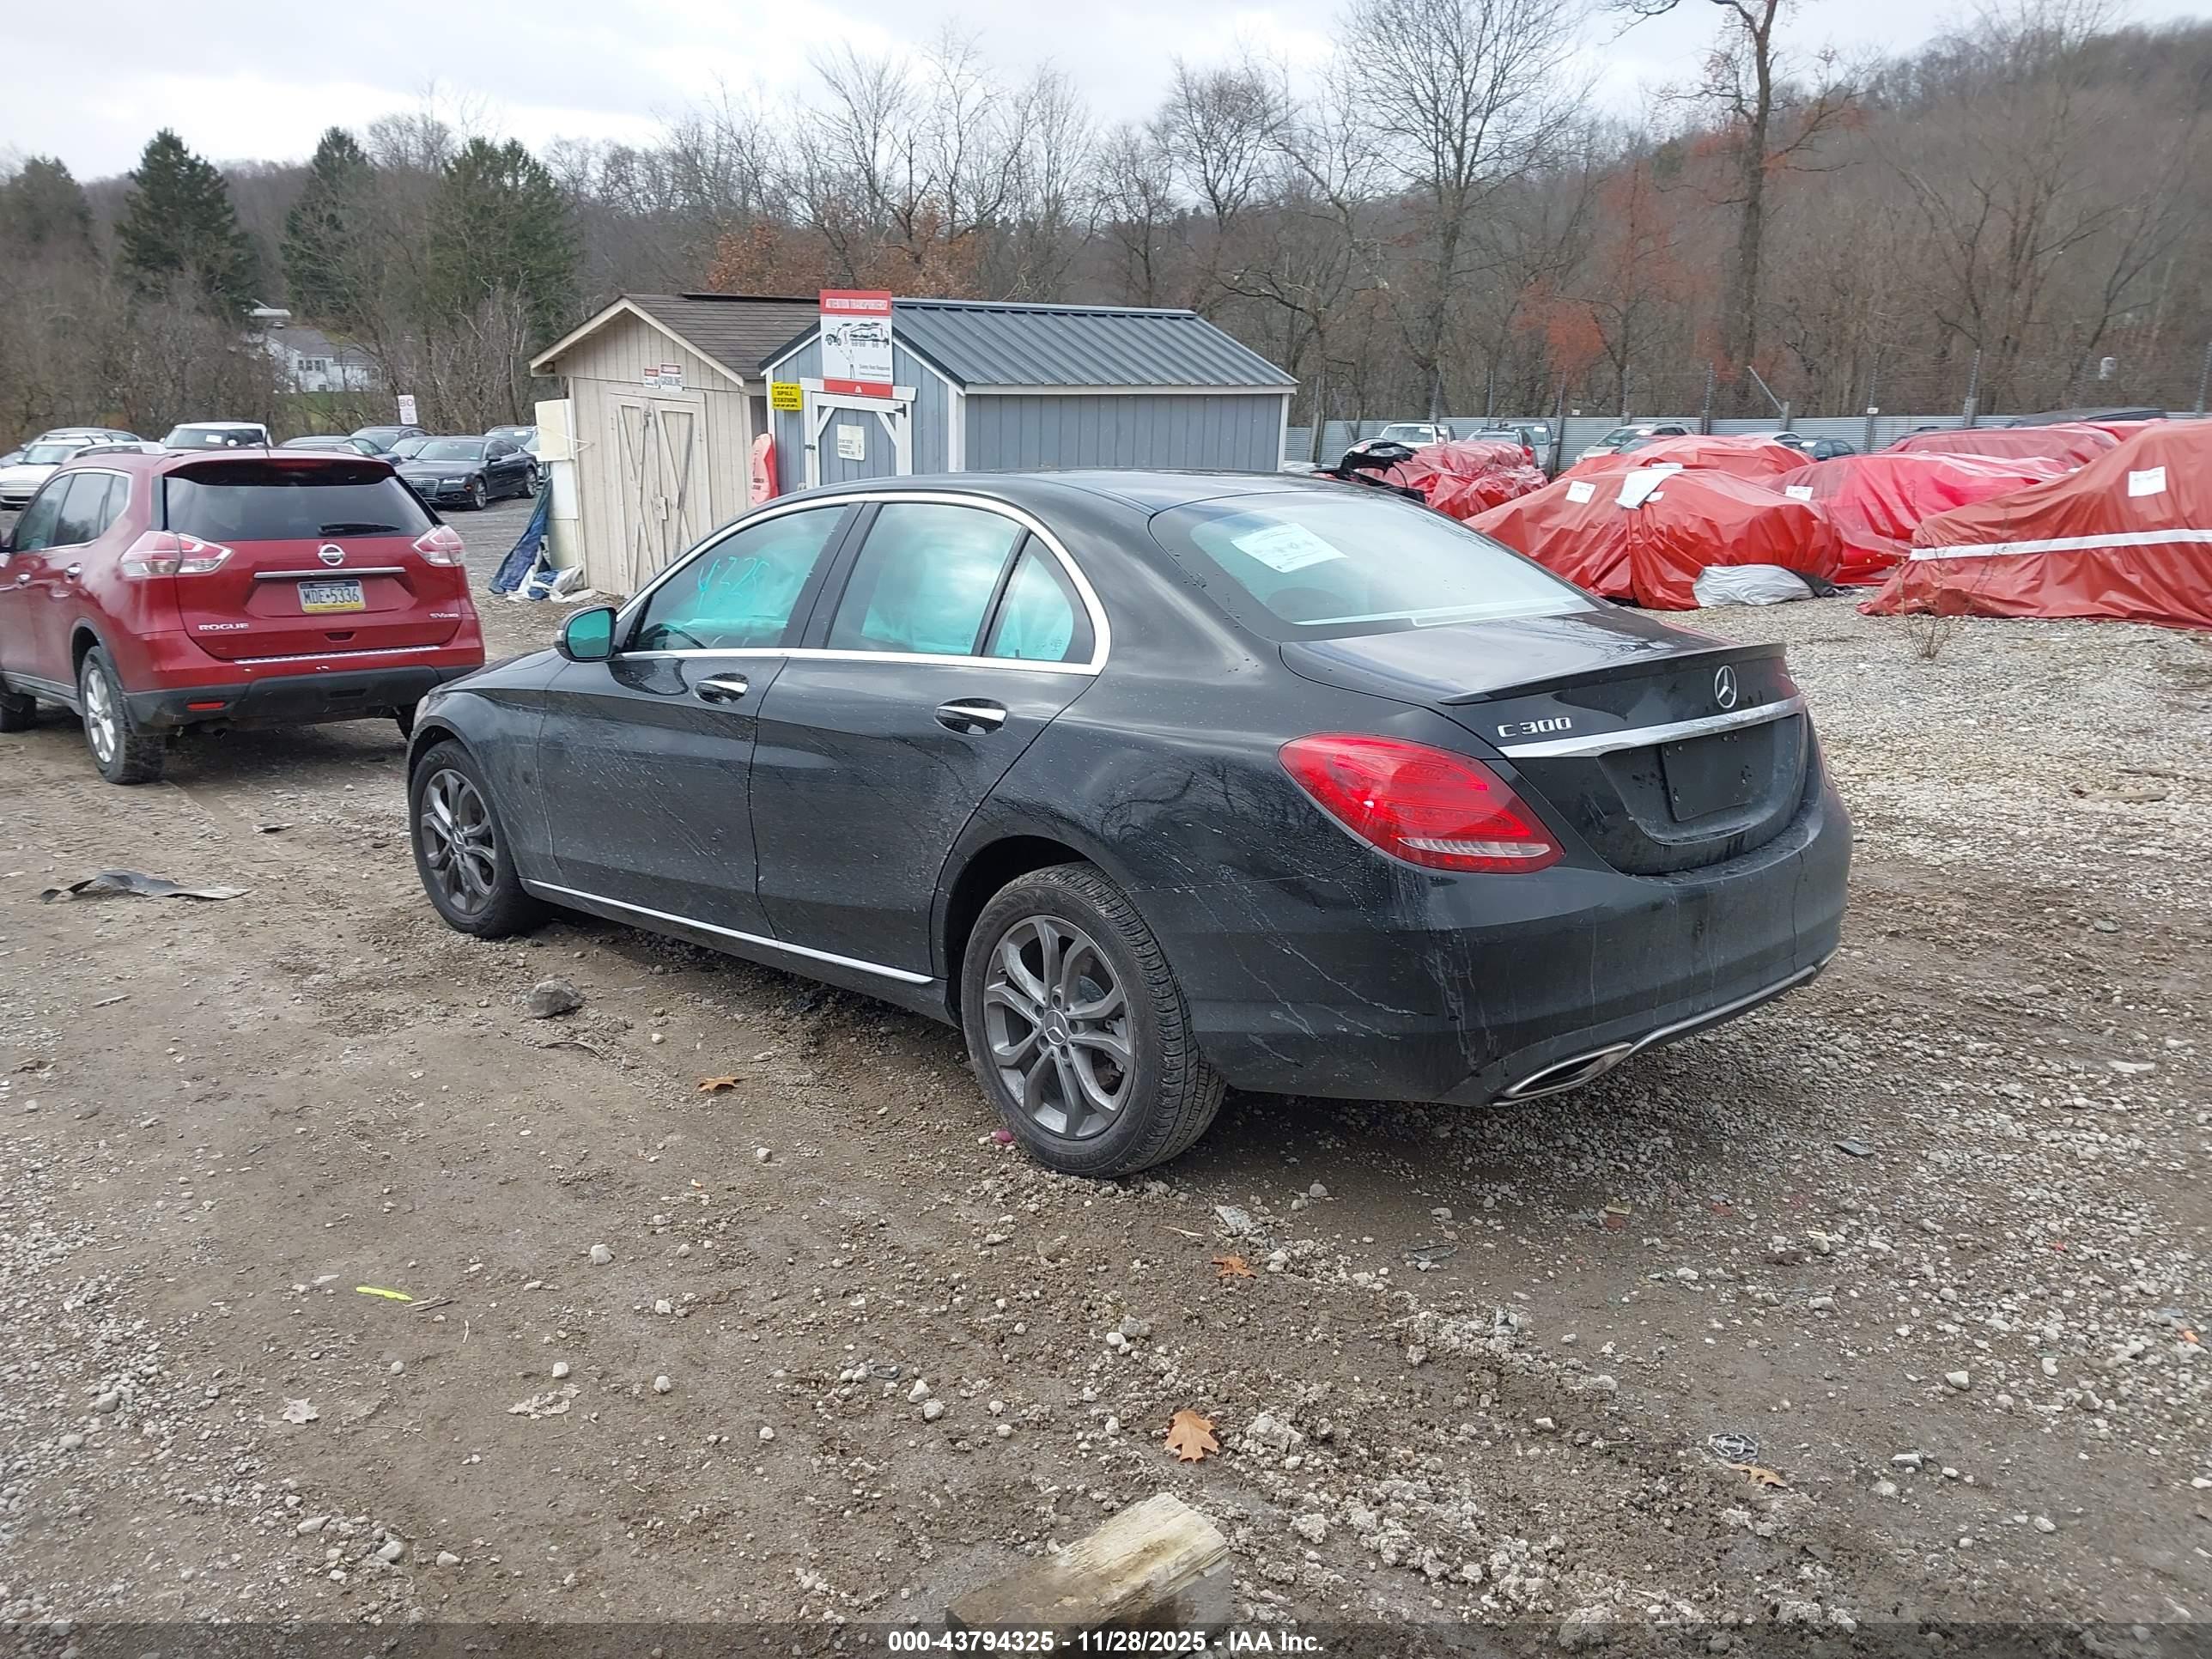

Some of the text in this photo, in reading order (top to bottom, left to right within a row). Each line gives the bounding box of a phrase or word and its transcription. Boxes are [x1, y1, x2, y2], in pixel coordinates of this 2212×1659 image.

[198, 623, 249, 631] ROGUE
[1497, 717, 1572, 738] C 300
